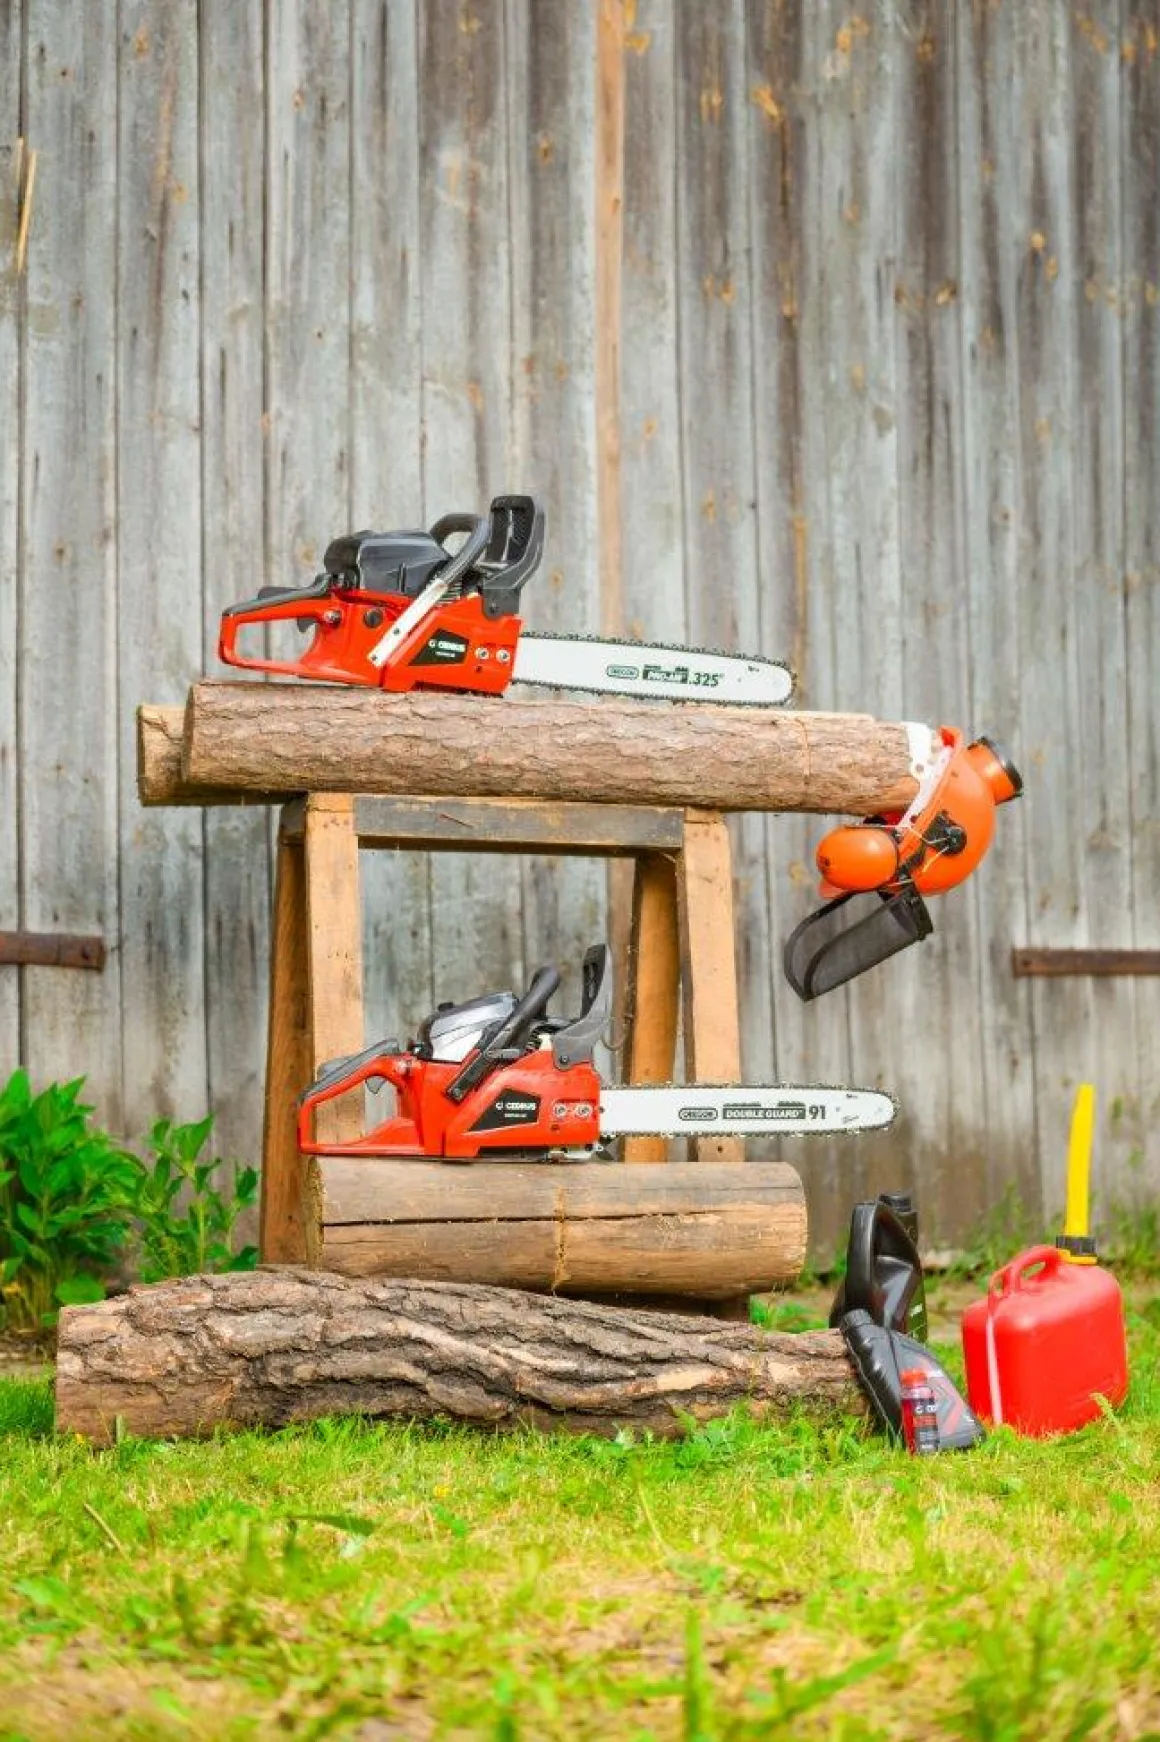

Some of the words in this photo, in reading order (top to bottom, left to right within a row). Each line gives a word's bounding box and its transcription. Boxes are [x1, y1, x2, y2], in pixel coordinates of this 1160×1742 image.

[506, 1102, 536, 1111] CEDRUS
[726, 1109, 764, 1118] DOUBLE
[809, 1105, 826, 1119] 91
